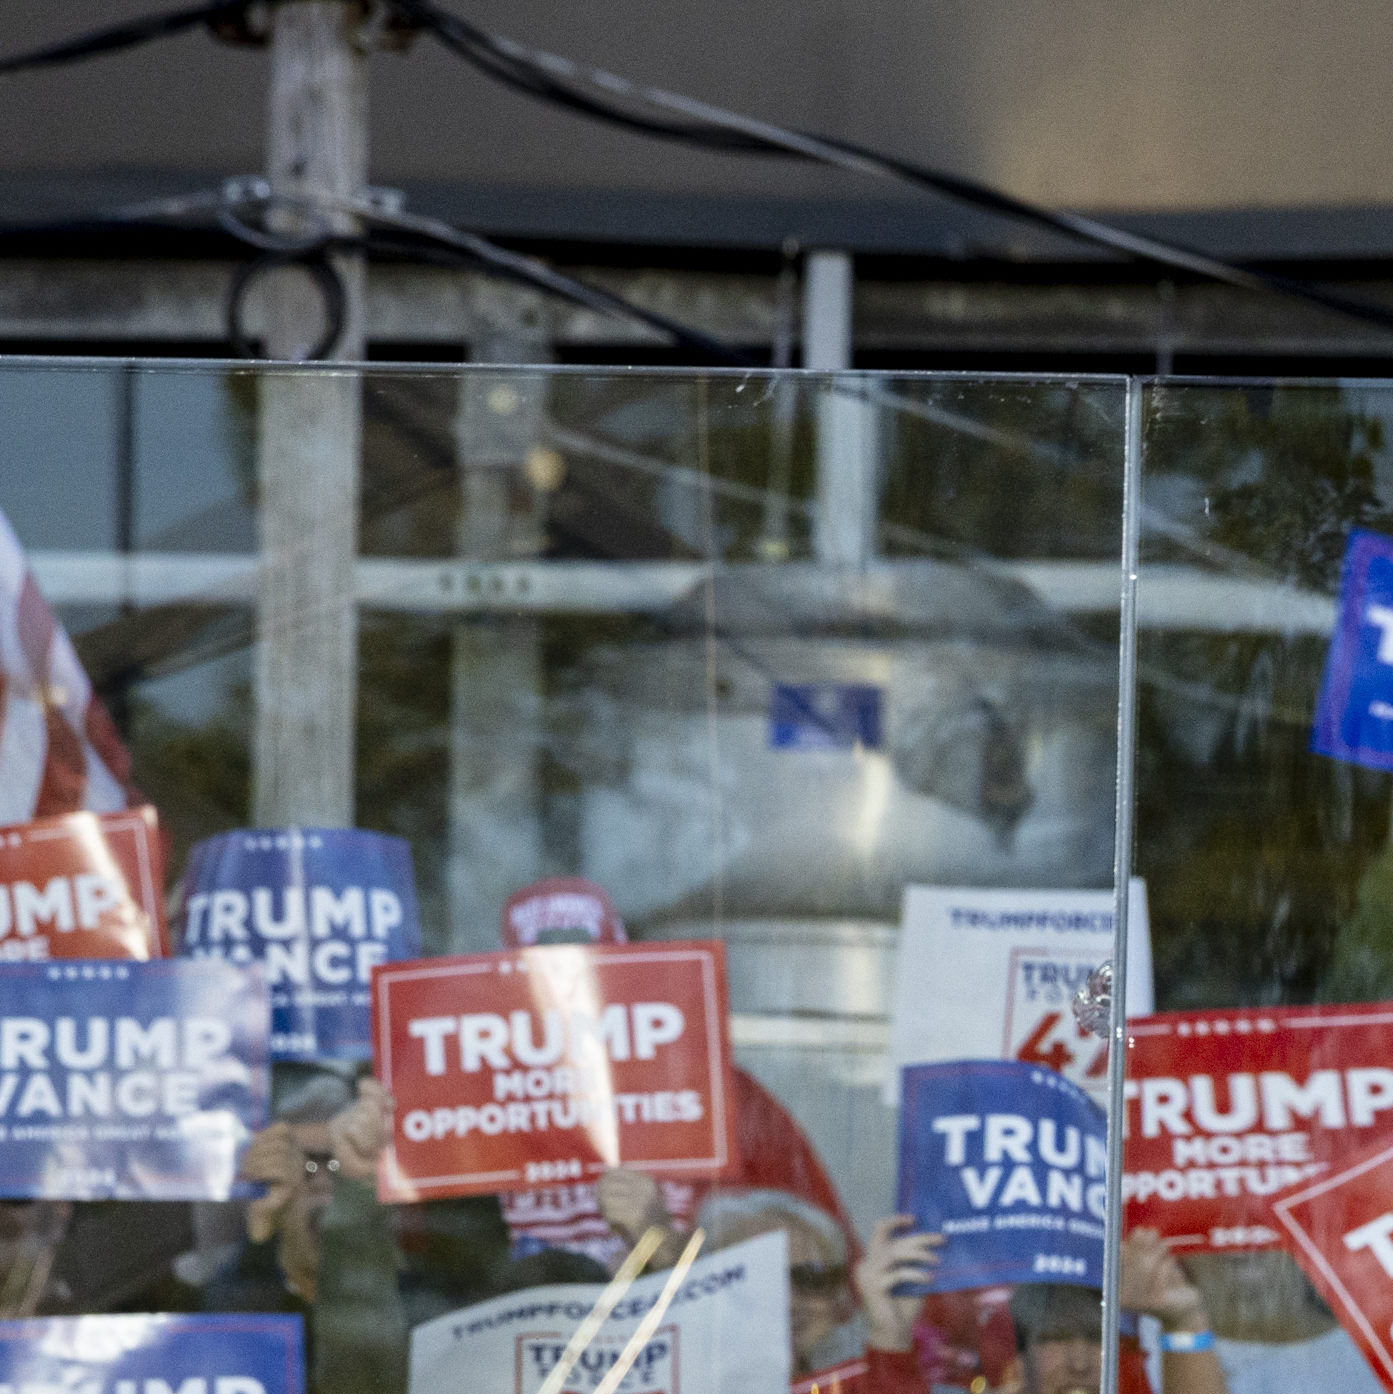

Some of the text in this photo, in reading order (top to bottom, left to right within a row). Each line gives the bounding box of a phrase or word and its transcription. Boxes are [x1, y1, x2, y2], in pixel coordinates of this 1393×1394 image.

[185, 886, 402, 946] TRUMP
[0, 1015, 232, 1071] RUMP
[931, 1114, 1106, 1179] TRU
[1171, 1131, 1313, 1168] MORE
